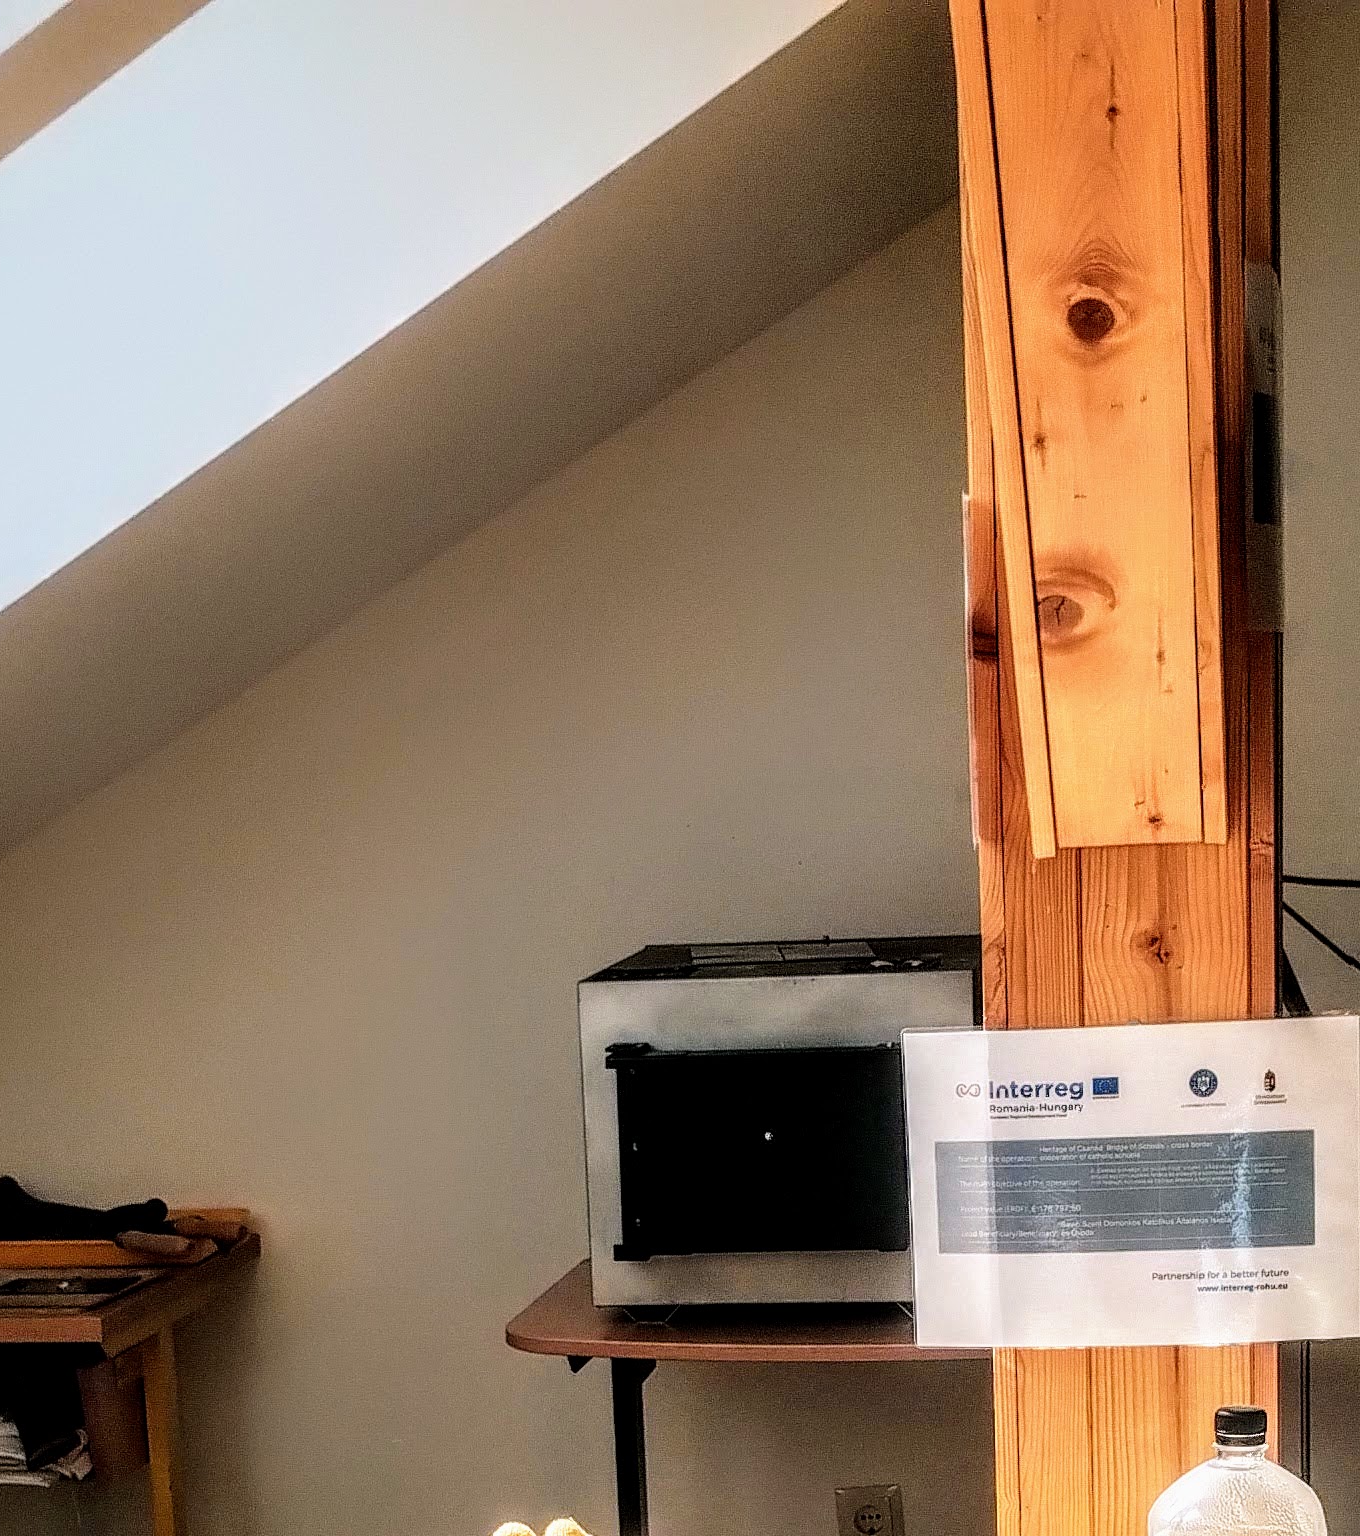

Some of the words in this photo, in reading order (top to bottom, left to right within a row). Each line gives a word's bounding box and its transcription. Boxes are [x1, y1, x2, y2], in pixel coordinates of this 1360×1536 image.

[989, 1080, 1084, 1100] Interreg
[989, 1103, 1084, 1113] Romania-Hungary
[1151, 1271, 1205, 1282] Partnership
[1207, 1271, 1220, 1279] for
[1230, 1270, 1259, 1279] better
[1260, 1269, 1289, 1278] future
